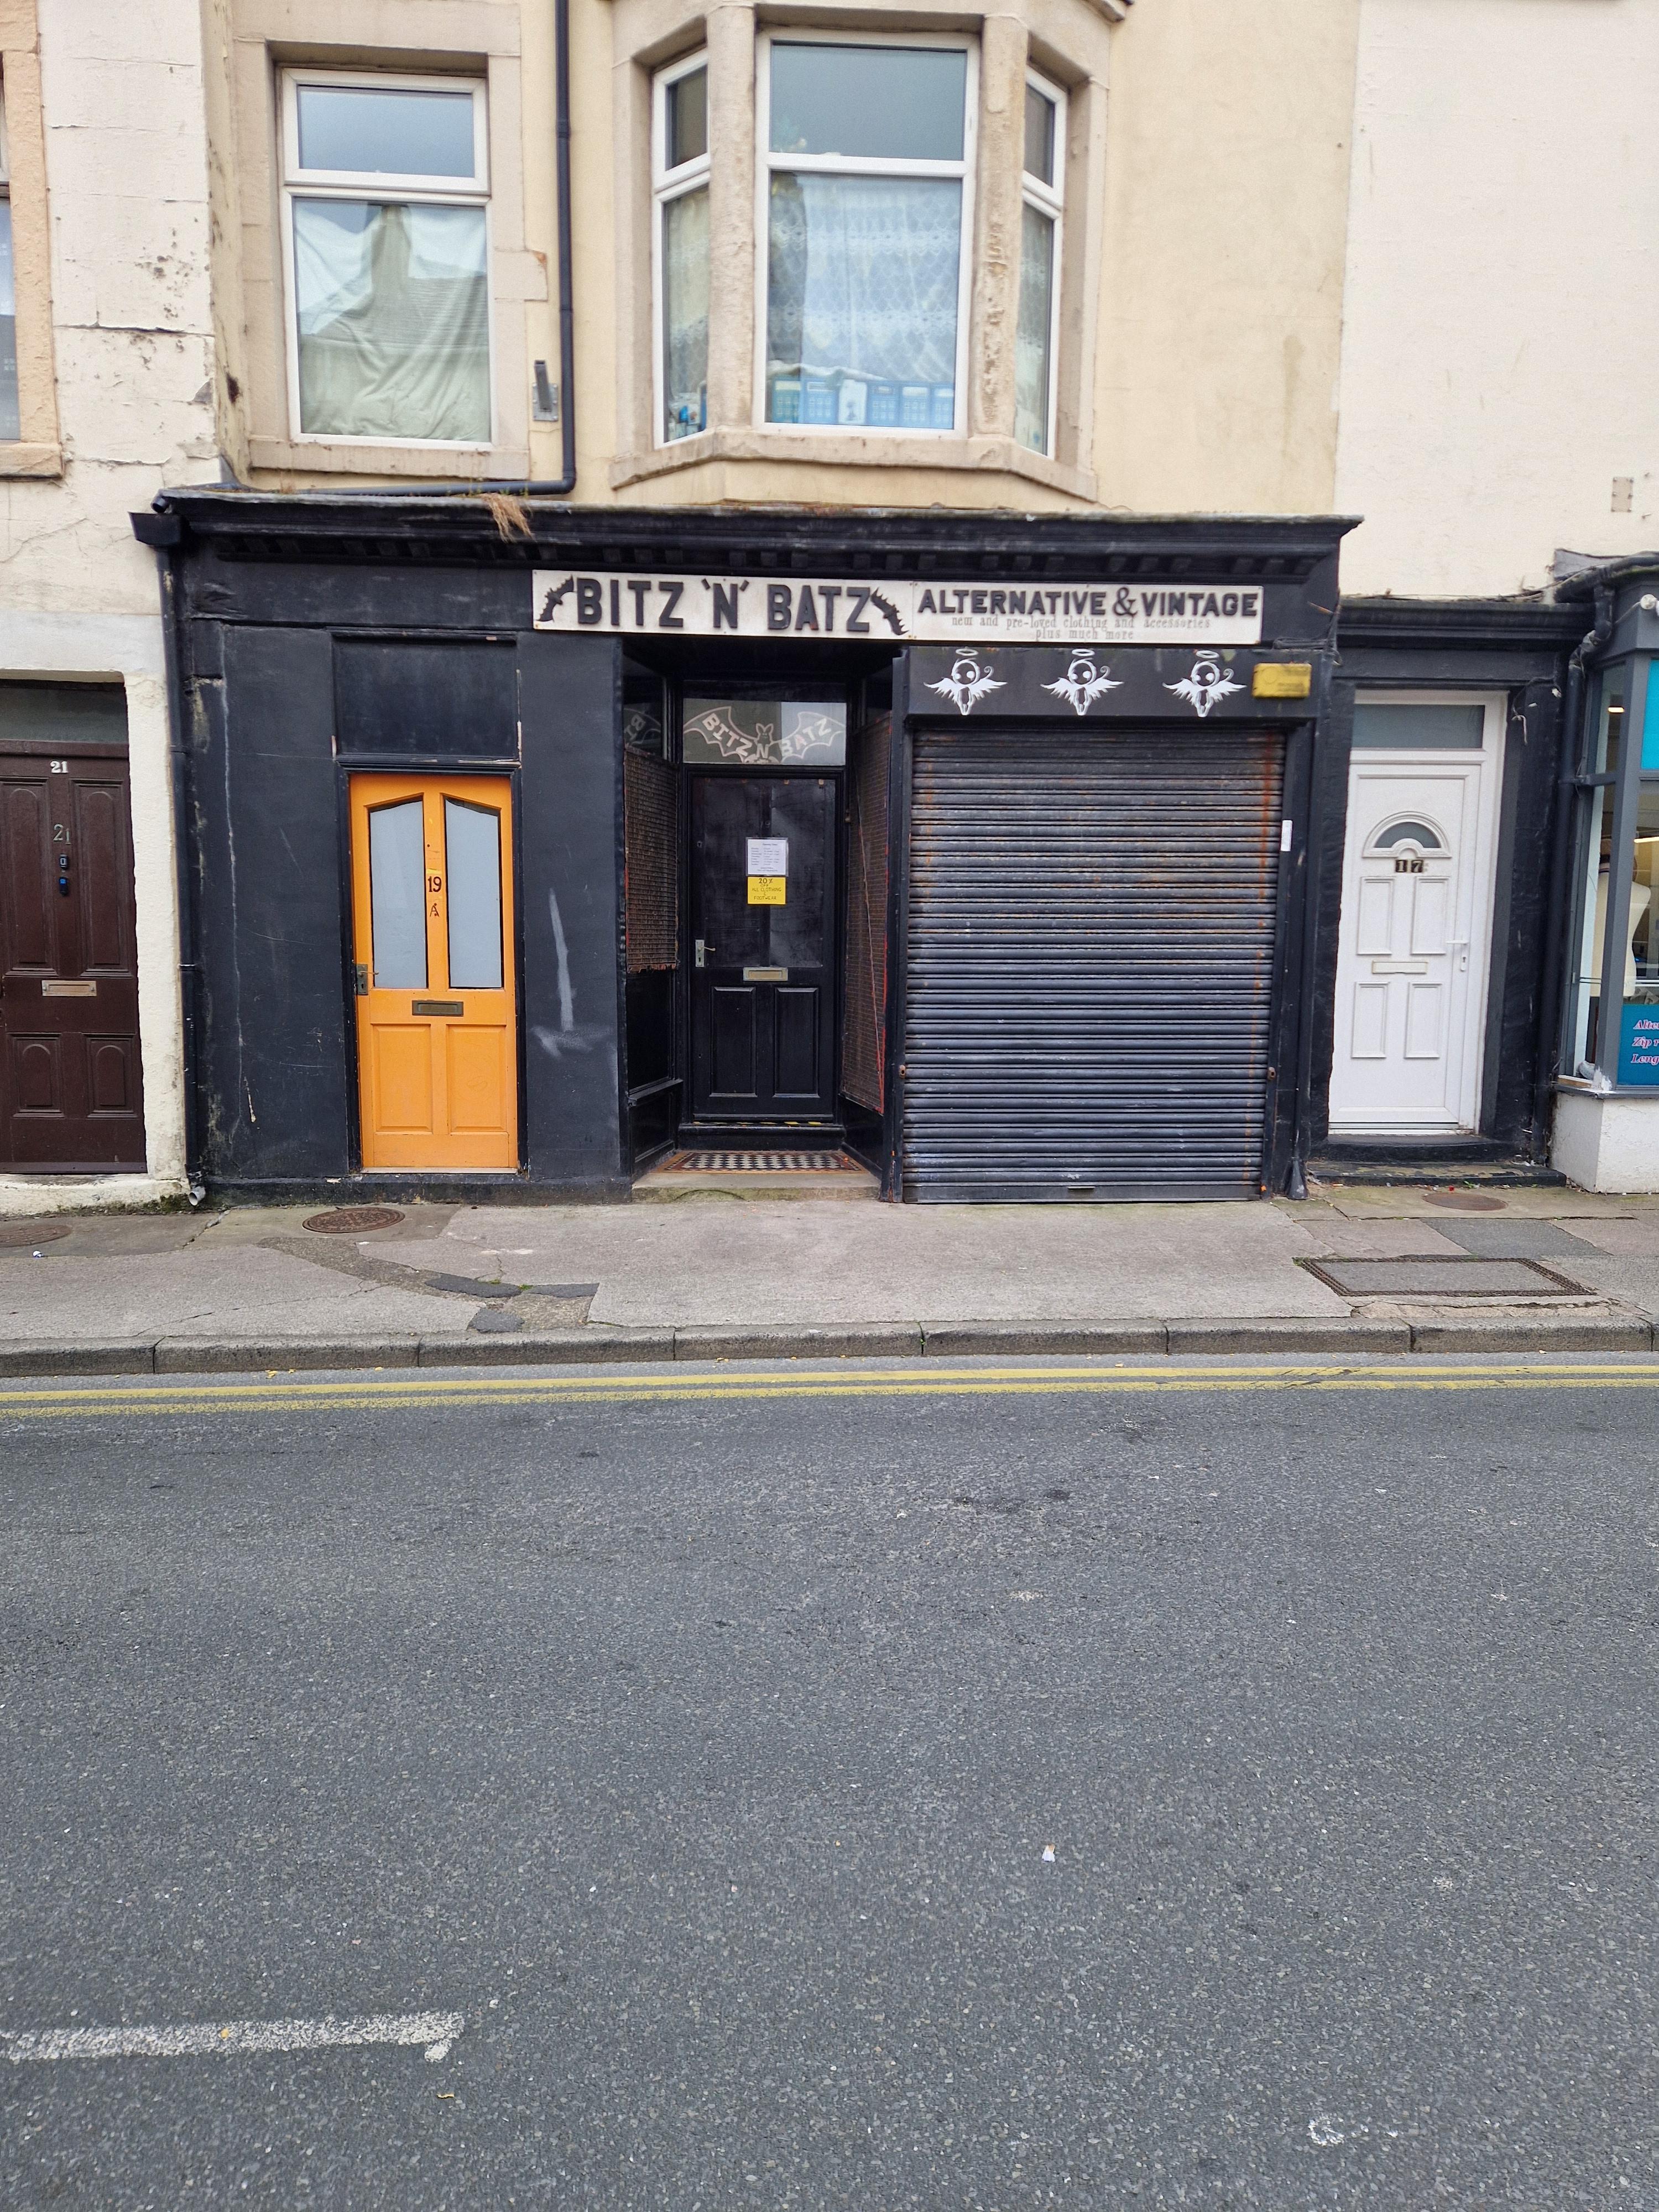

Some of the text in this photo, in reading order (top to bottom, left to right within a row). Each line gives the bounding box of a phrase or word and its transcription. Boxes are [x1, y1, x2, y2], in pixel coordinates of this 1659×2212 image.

[577, 578, 684, 627] BITZ
[767, 584, 870, 633] BATZ
[918, 587, 1258, 618] ALTERNATIVE & VINTAGE
[980, 614, 999, 627] and
[1006, 615, 1057, 630] pre-loved
[1063, 615, 1108, 632] clothing
[1114, 616, 1135, 628] and
[1144, 618, 1211, 628] accessories
[1035, 627, 1134, 641] plus much more
[702, 712, 832, 759] BITZ N BATZ
[50, 761, 68, 773] 21
[53, 824, 71, 845] 21
[1396, 860, 1423, 873] 17
[428, 877, 441, 892] 19
[1632, 1036, 1651, 1048] Zip
